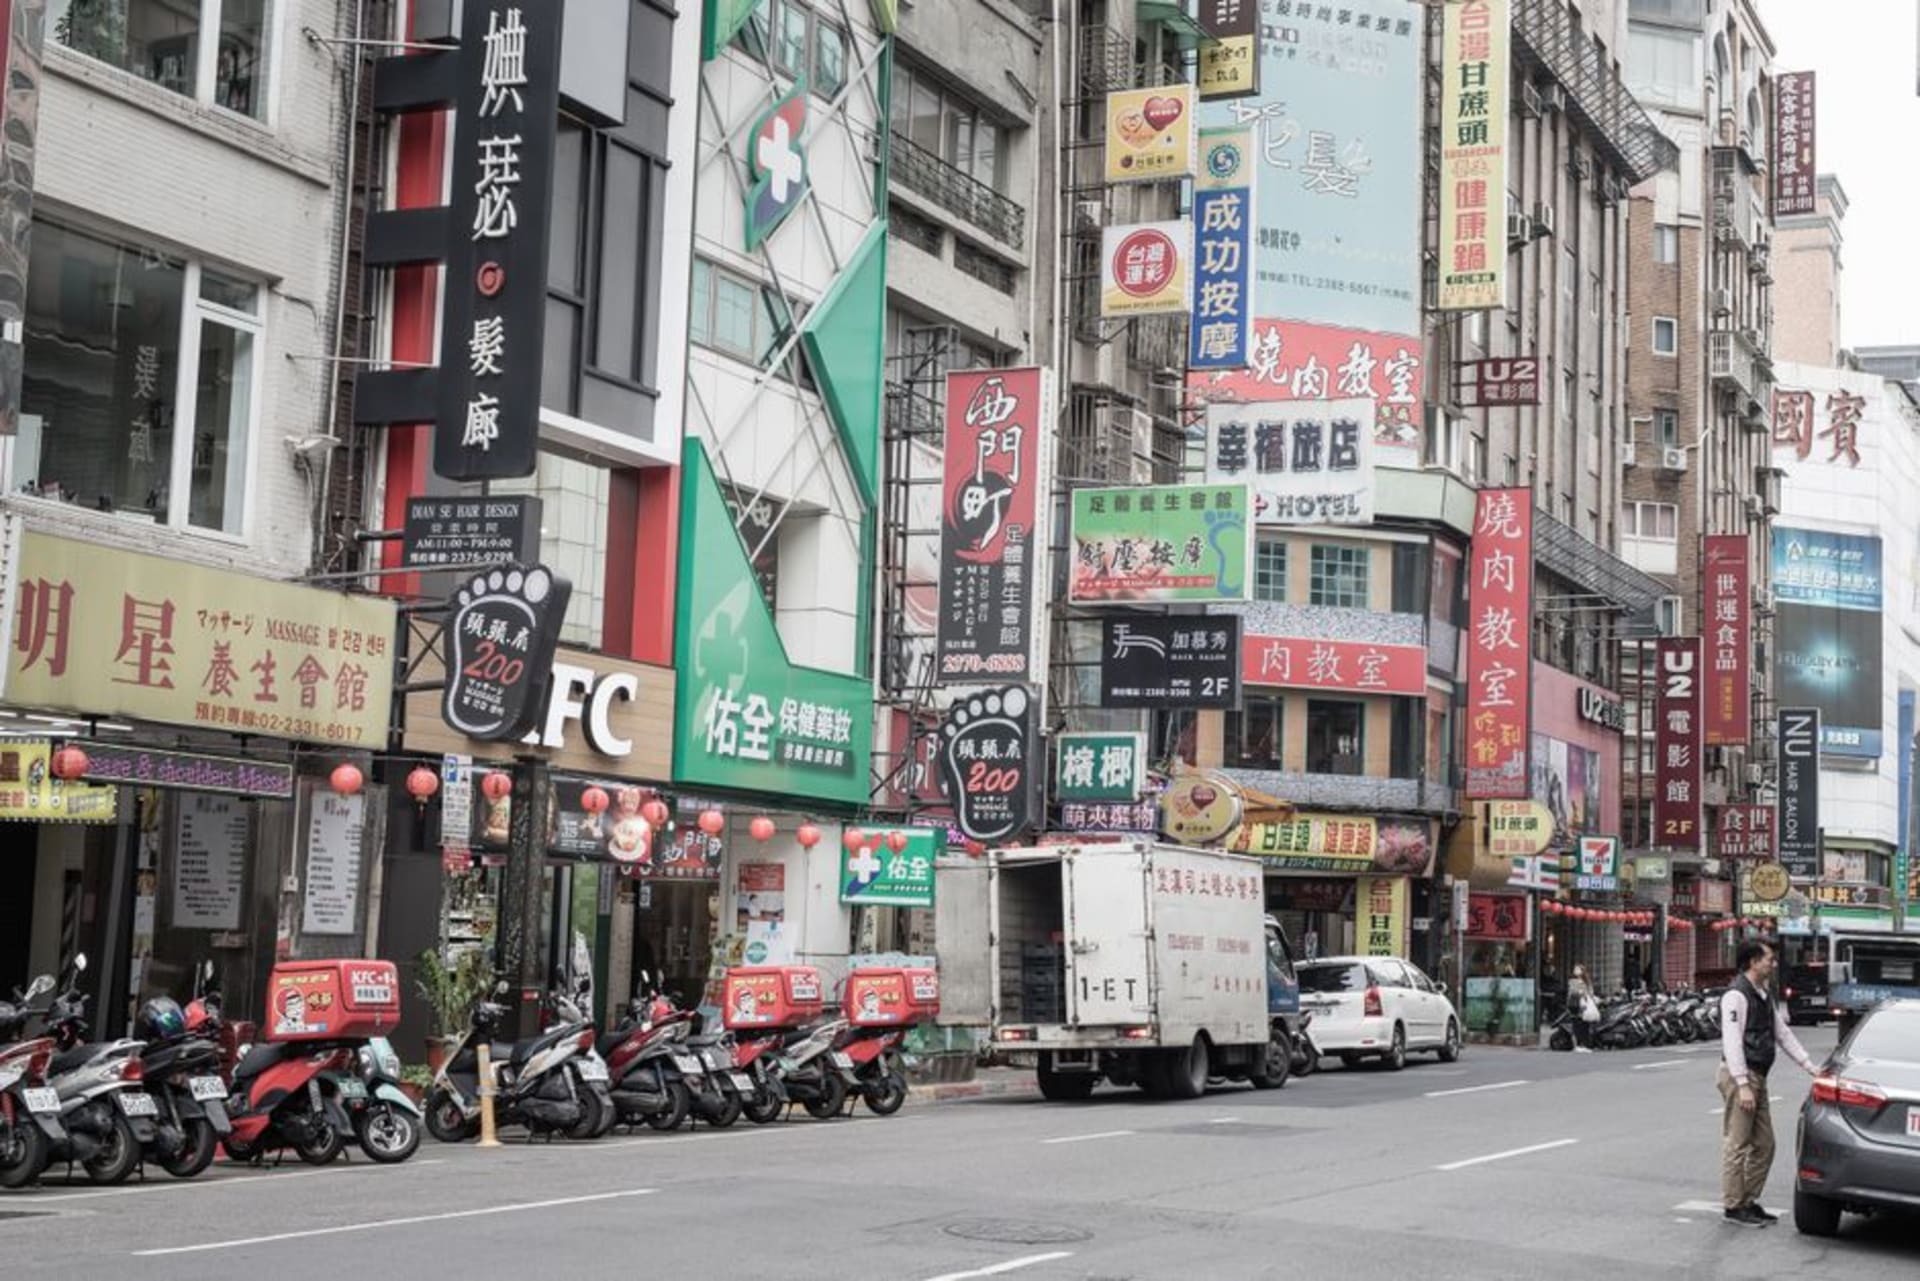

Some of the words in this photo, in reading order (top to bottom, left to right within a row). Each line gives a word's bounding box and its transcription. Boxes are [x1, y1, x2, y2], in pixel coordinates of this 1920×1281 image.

[1454, 180, 1488, 273] 健康鍋
[1198, 193, 1244, 360] 成功按摩
[461, 315, 506, 453] 髮廊
[1481, 361, 1536, 381] U2
[1483, 383, 1537, 401] 電影館
[1216, 418, 1363, 474] 幸福旅店
[1772, 388, 1866, 468] 國賓
[962, 377, 1023, 550] 西門町
[485, 503, 520, 518] DESIGN
[1277, 494, 1361, 517] HOTEL
[965, 566, 976, 636] MASSAGE
[1477, 494, 1523, 708] 燒肉教室
[1715, 574, 1738, 671] 世運食品
[197, 609, 255, 636] マッサージ
[265, 618, 322, 646] MASSAGE
[1170, 631, 1227, 650] 加慕秀
[201, 640, 369, 712] 養生會館
[464, 641, 524, 686] 200
[1201, 677, 1229, 696] 2F
[1261, 641, 1391, 689] 肉教室
[1663, 651, 1694, 698] U2
[520, 661, 639, 758] FC
[704, 686, 775, 761] 佑全
[779, 696, 853, 744] 保健藥妝
[1581, 688, 1602, 722] U2
[1667, 711, 1692, 801] 電影館
[1785, 716, 1811, 757] NU
[967, 761, 1020, 792] 200
[1062, 745, 1132, 788] 檳榔
[1787, 761, 1798, 790] HAIR
[1664, 819, 1692, 834] 2F
[1786, 797, 1798, 840] SALON
[887, 856, 929, 881] 佑全
